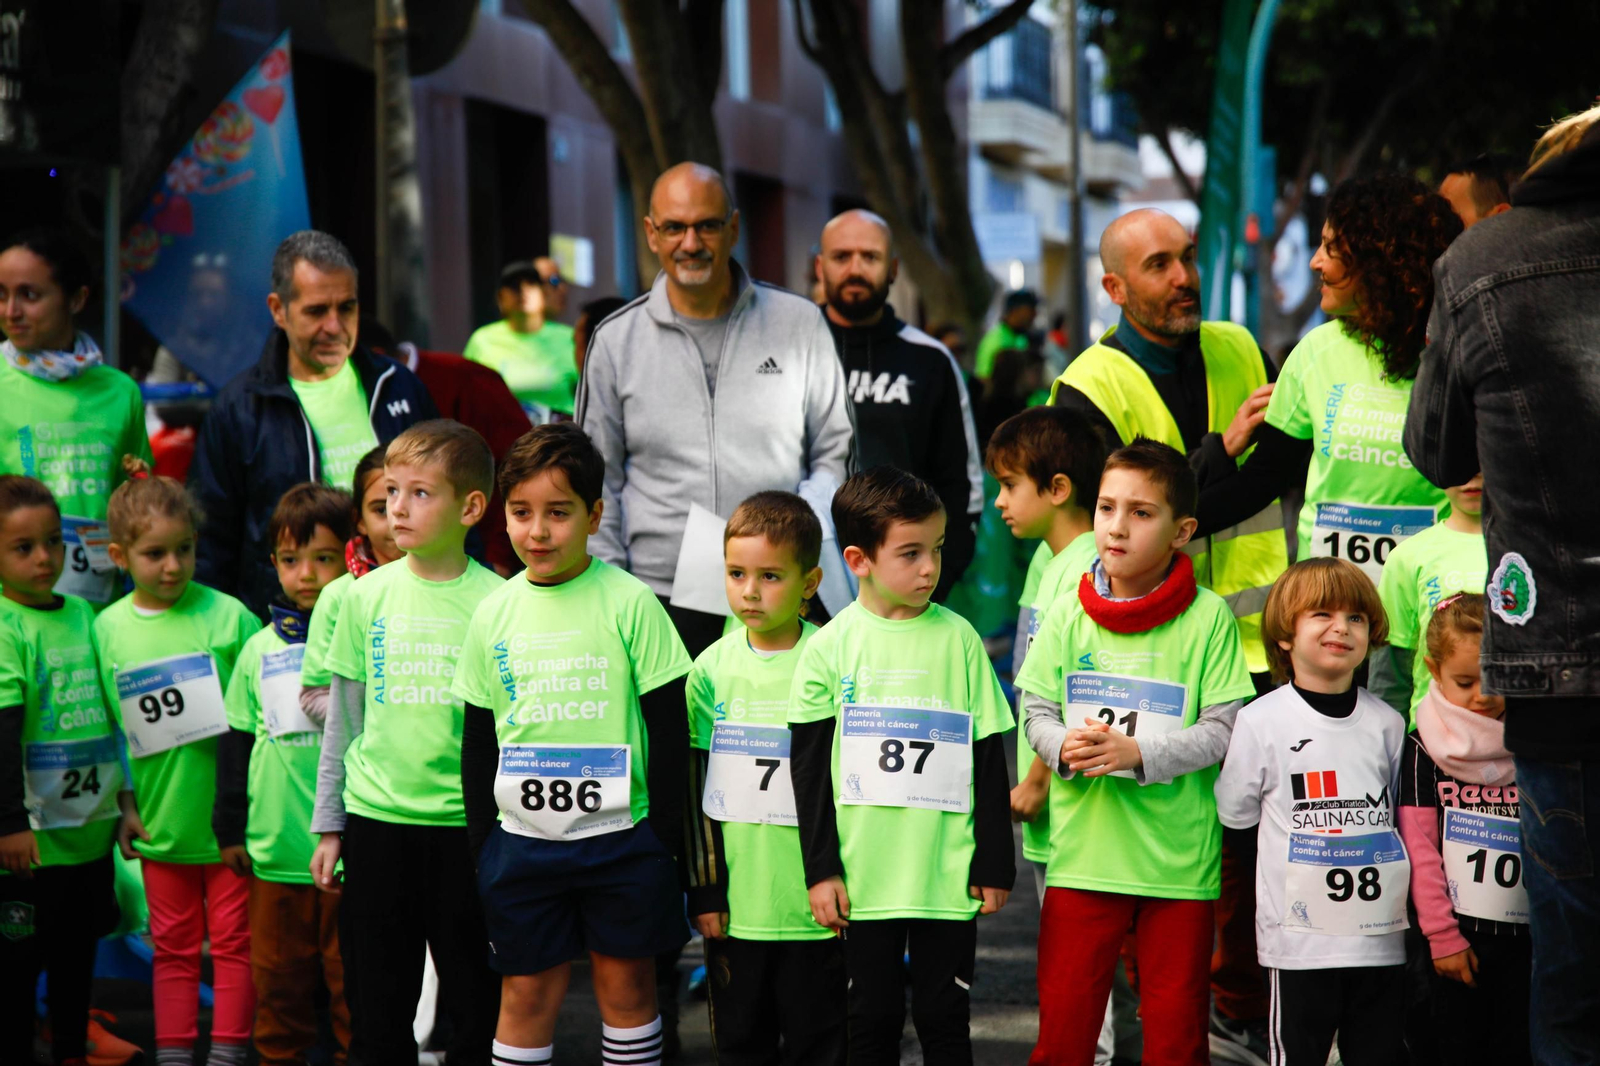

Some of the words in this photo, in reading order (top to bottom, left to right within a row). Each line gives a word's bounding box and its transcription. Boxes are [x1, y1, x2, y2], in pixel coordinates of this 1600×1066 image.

[1342, 403, 1364, 418] En
[1321, 383, 1346, 458] ALMERÍA
[1338, 422, 1402, 444] contra
[1321, 504, 1348, 514] Almería
[1319, 513, 1343, 522] contra
[1344, 516, 1352, 524] el
[1353, 518, 1382, 527] cáncer
[1323, 531, 1397, 566] 160
[388, 639, 410, 655] En
[368, 616, 386, 704] ALMERÍA
[388, 659, 455, 678] contra
[513, 660, 534, 676] En
[537, 652, 609, 672] marcha
[493, 639, 517, 726] AMERÍA
[516, 674, 582, 696] contra
[587, 671, 608, 690] el
[1071, 677, 1102, 686] Almería
[1071, 686, 1097, 696] contra
[139, 687, 185, 723] 99
[517, 698, 609, 725] cáncer
[882, 695, 951, 709] marcha
[847, 709, 881, 718] Almería
[1098, 707, 1138, 738] 21
[716, 727, 745, 736] Almería
[847, 720, 875, 728] contra
[876, 719, 886, 728] el
[887, 720, 919, 729] cáncer
[715, 738, 739, 746] contra
[749, 739, 779, 748] cáncer
[505, 750, 535, 758] Almería
[878, 739, 935, 775] 87
[505, 760, 529, 768] contra
[530, 760, 539, 768] el
[540, 760, 571, 768] cáncer
[62, 766, 100, 800] 24
[755, 758, 781, 791] 7
[521, 779, 602, 813] 886
[1322, 800, 1340, 809] Club
[1292, 810, 1365, 830] SALINAS
[1451, 814, 1485, 828] Almería
[1292, 836, 1326, 847] Almería
[1450, 825, 1478, 837] contra
[1479, 830, 1489, 839] el
[1490, 832, 1520, 844] cánce
[1292, 847, 1320, 857] contra
[1321, 849, 1331, 857] el
[1333, 849, 1365, 858] cáncer
[1466, 849, 1526, 890] 10
[1326, 867, 1382, 902] 98
